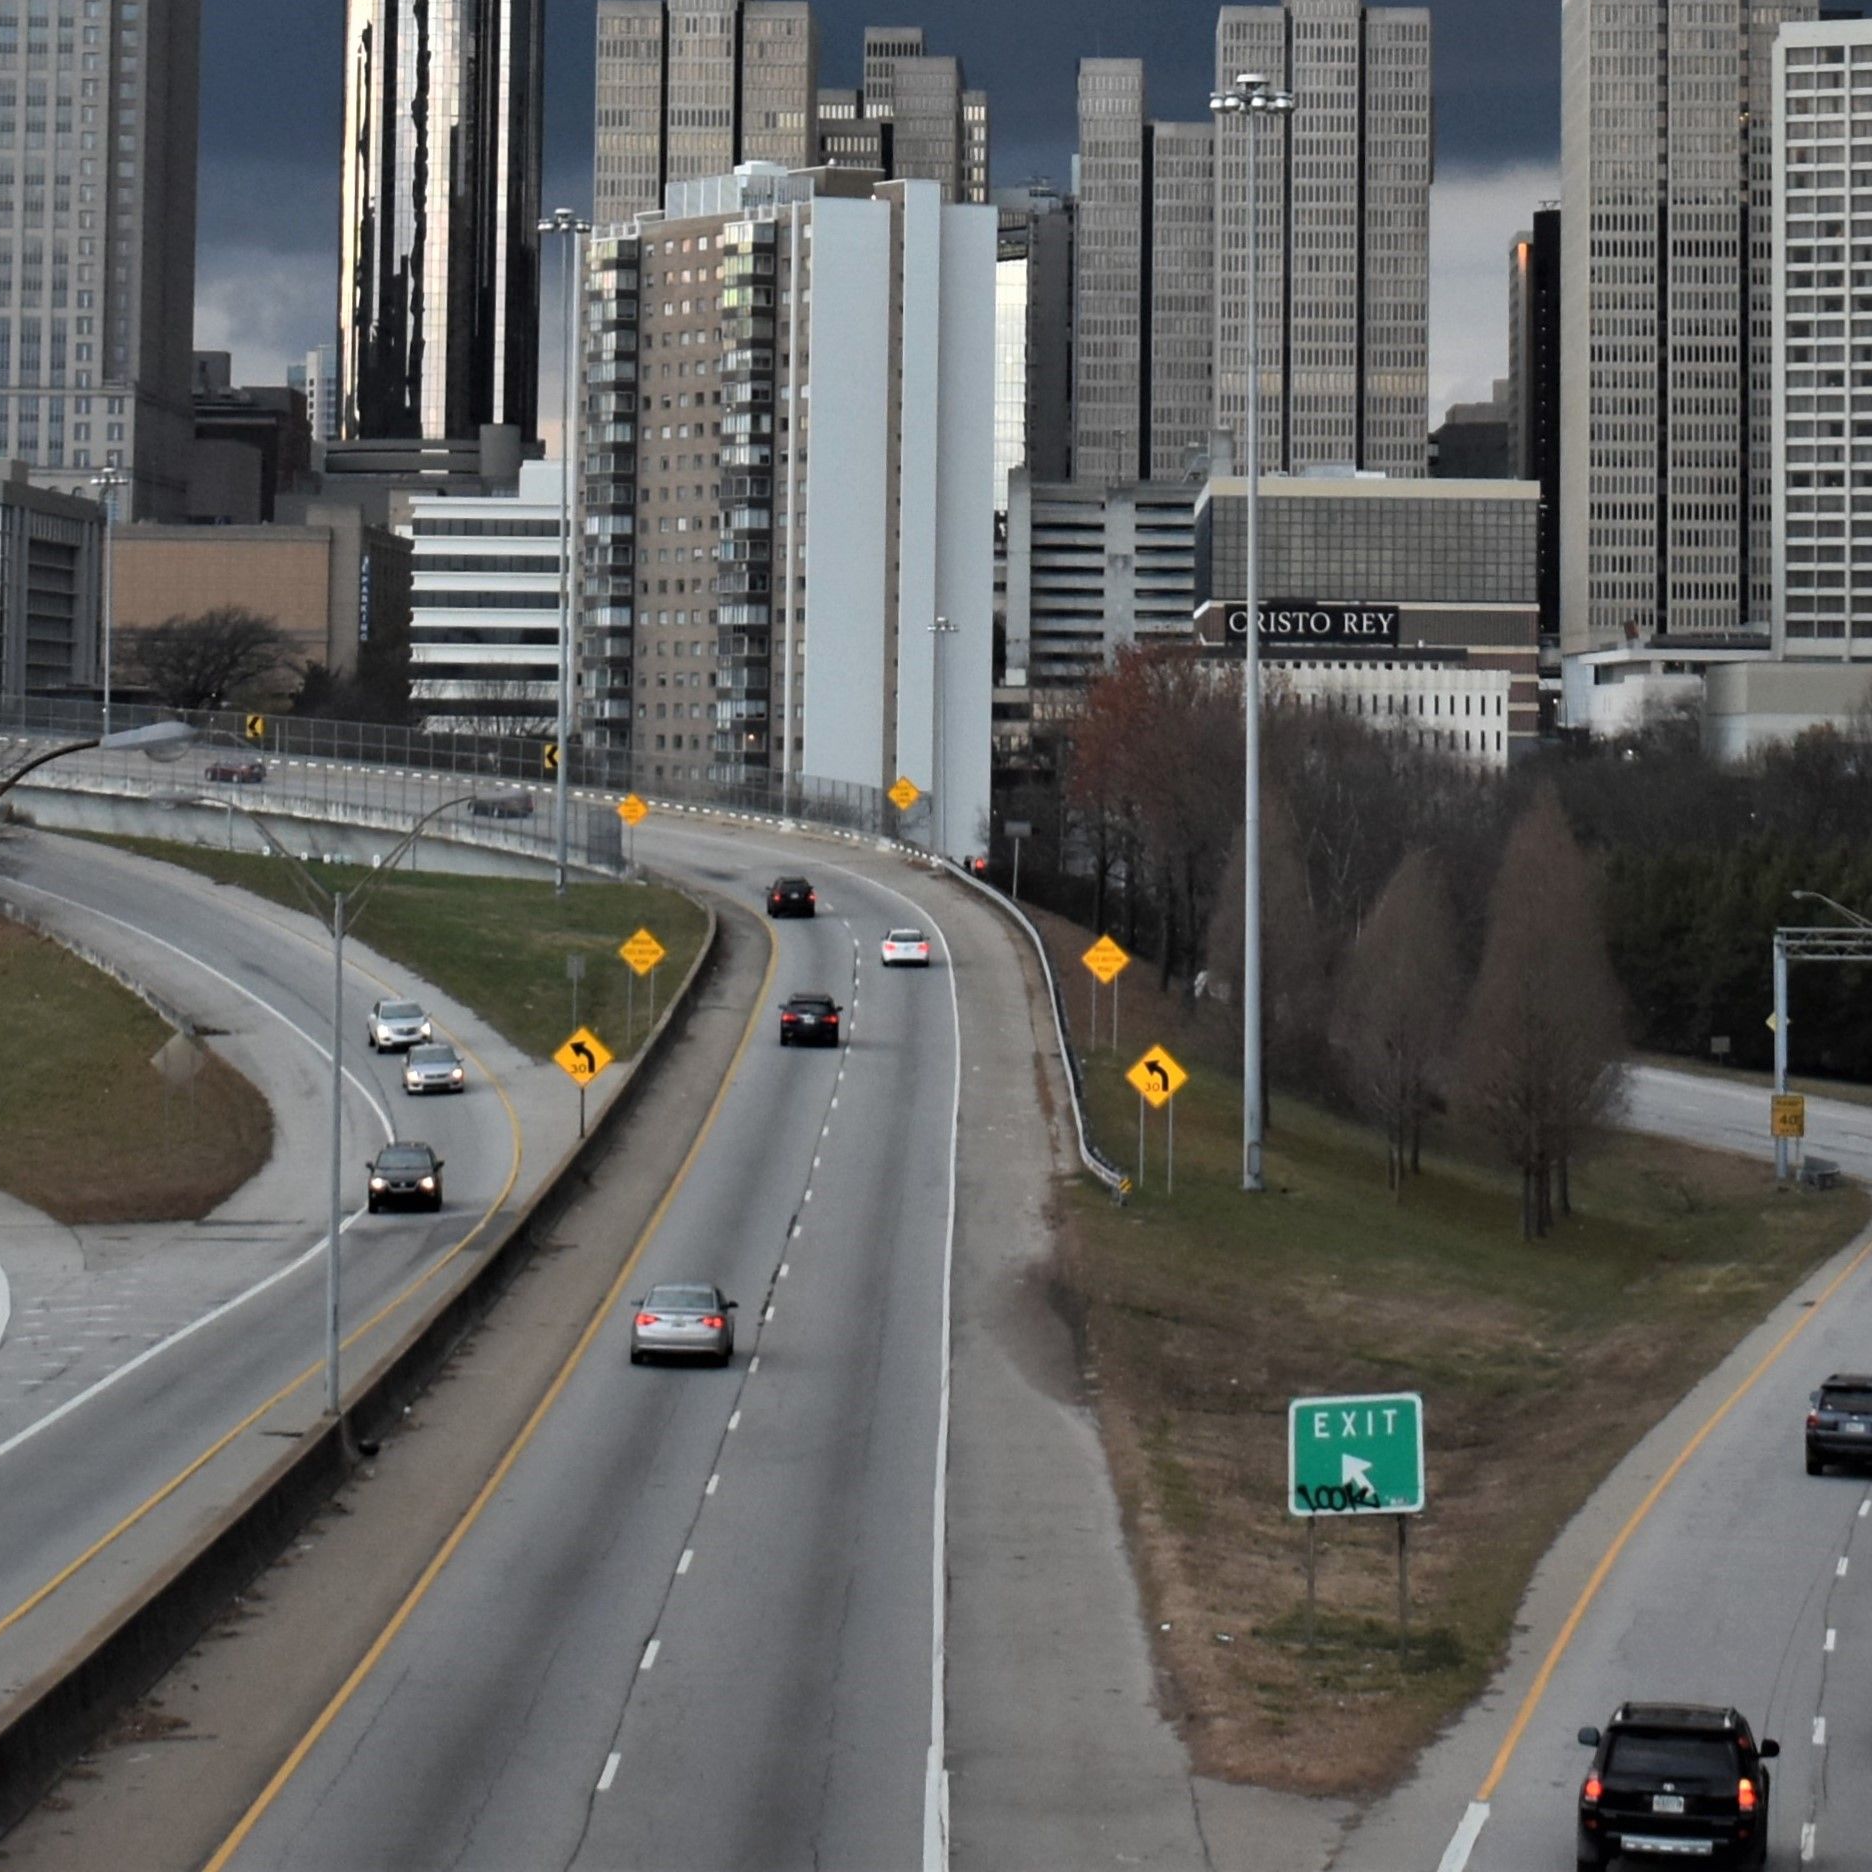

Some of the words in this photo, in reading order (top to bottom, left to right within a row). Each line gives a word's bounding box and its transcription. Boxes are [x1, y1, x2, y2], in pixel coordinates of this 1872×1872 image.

[1229, 611, 1331, 634] CRISTO
[1344, 613, 1394, 634] REY
[571, 1064, 586, 1073] 30
[1145, 1082, 1160, 1091] 30
[1314, 1409, 1397, 1438] EXIT
